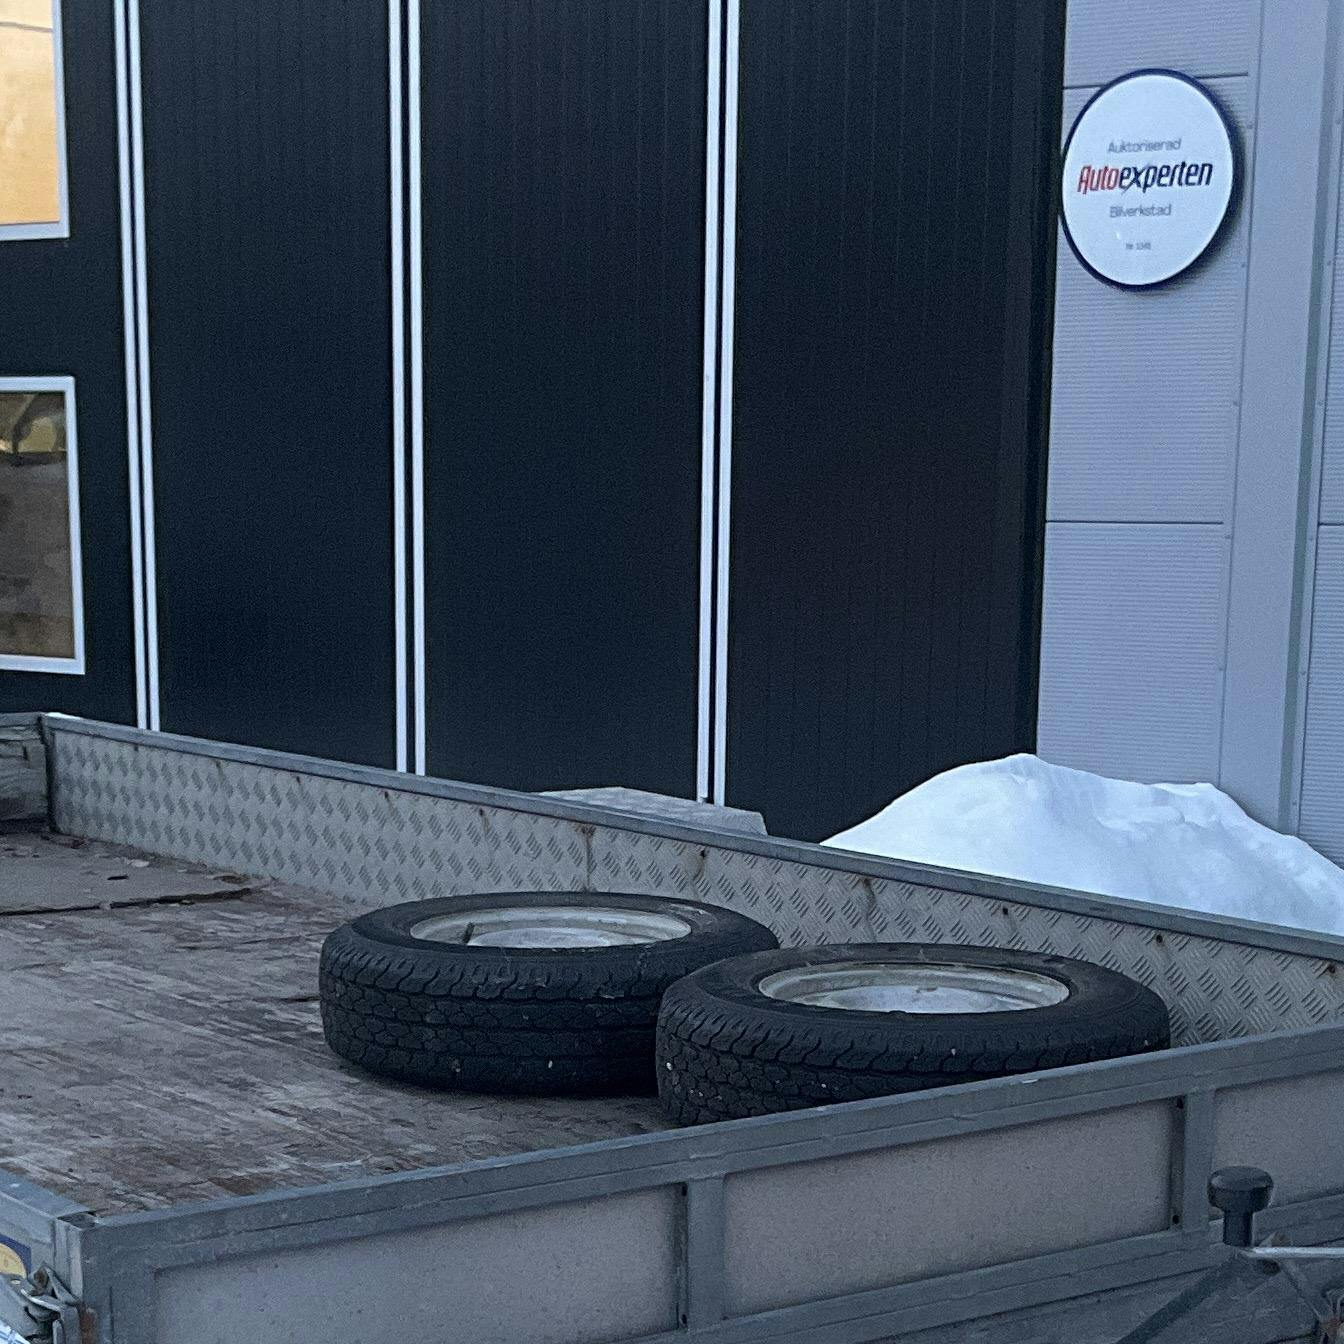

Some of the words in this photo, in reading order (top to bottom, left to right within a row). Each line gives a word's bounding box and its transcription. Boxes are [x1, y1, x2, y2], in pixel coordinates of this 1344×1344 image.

[1107, 138, 1182, 154] Auktoriserad
[1077, 161, 1213, 195] Autoexperten
[1109, 203, 1172, 219] Bilverkstad
